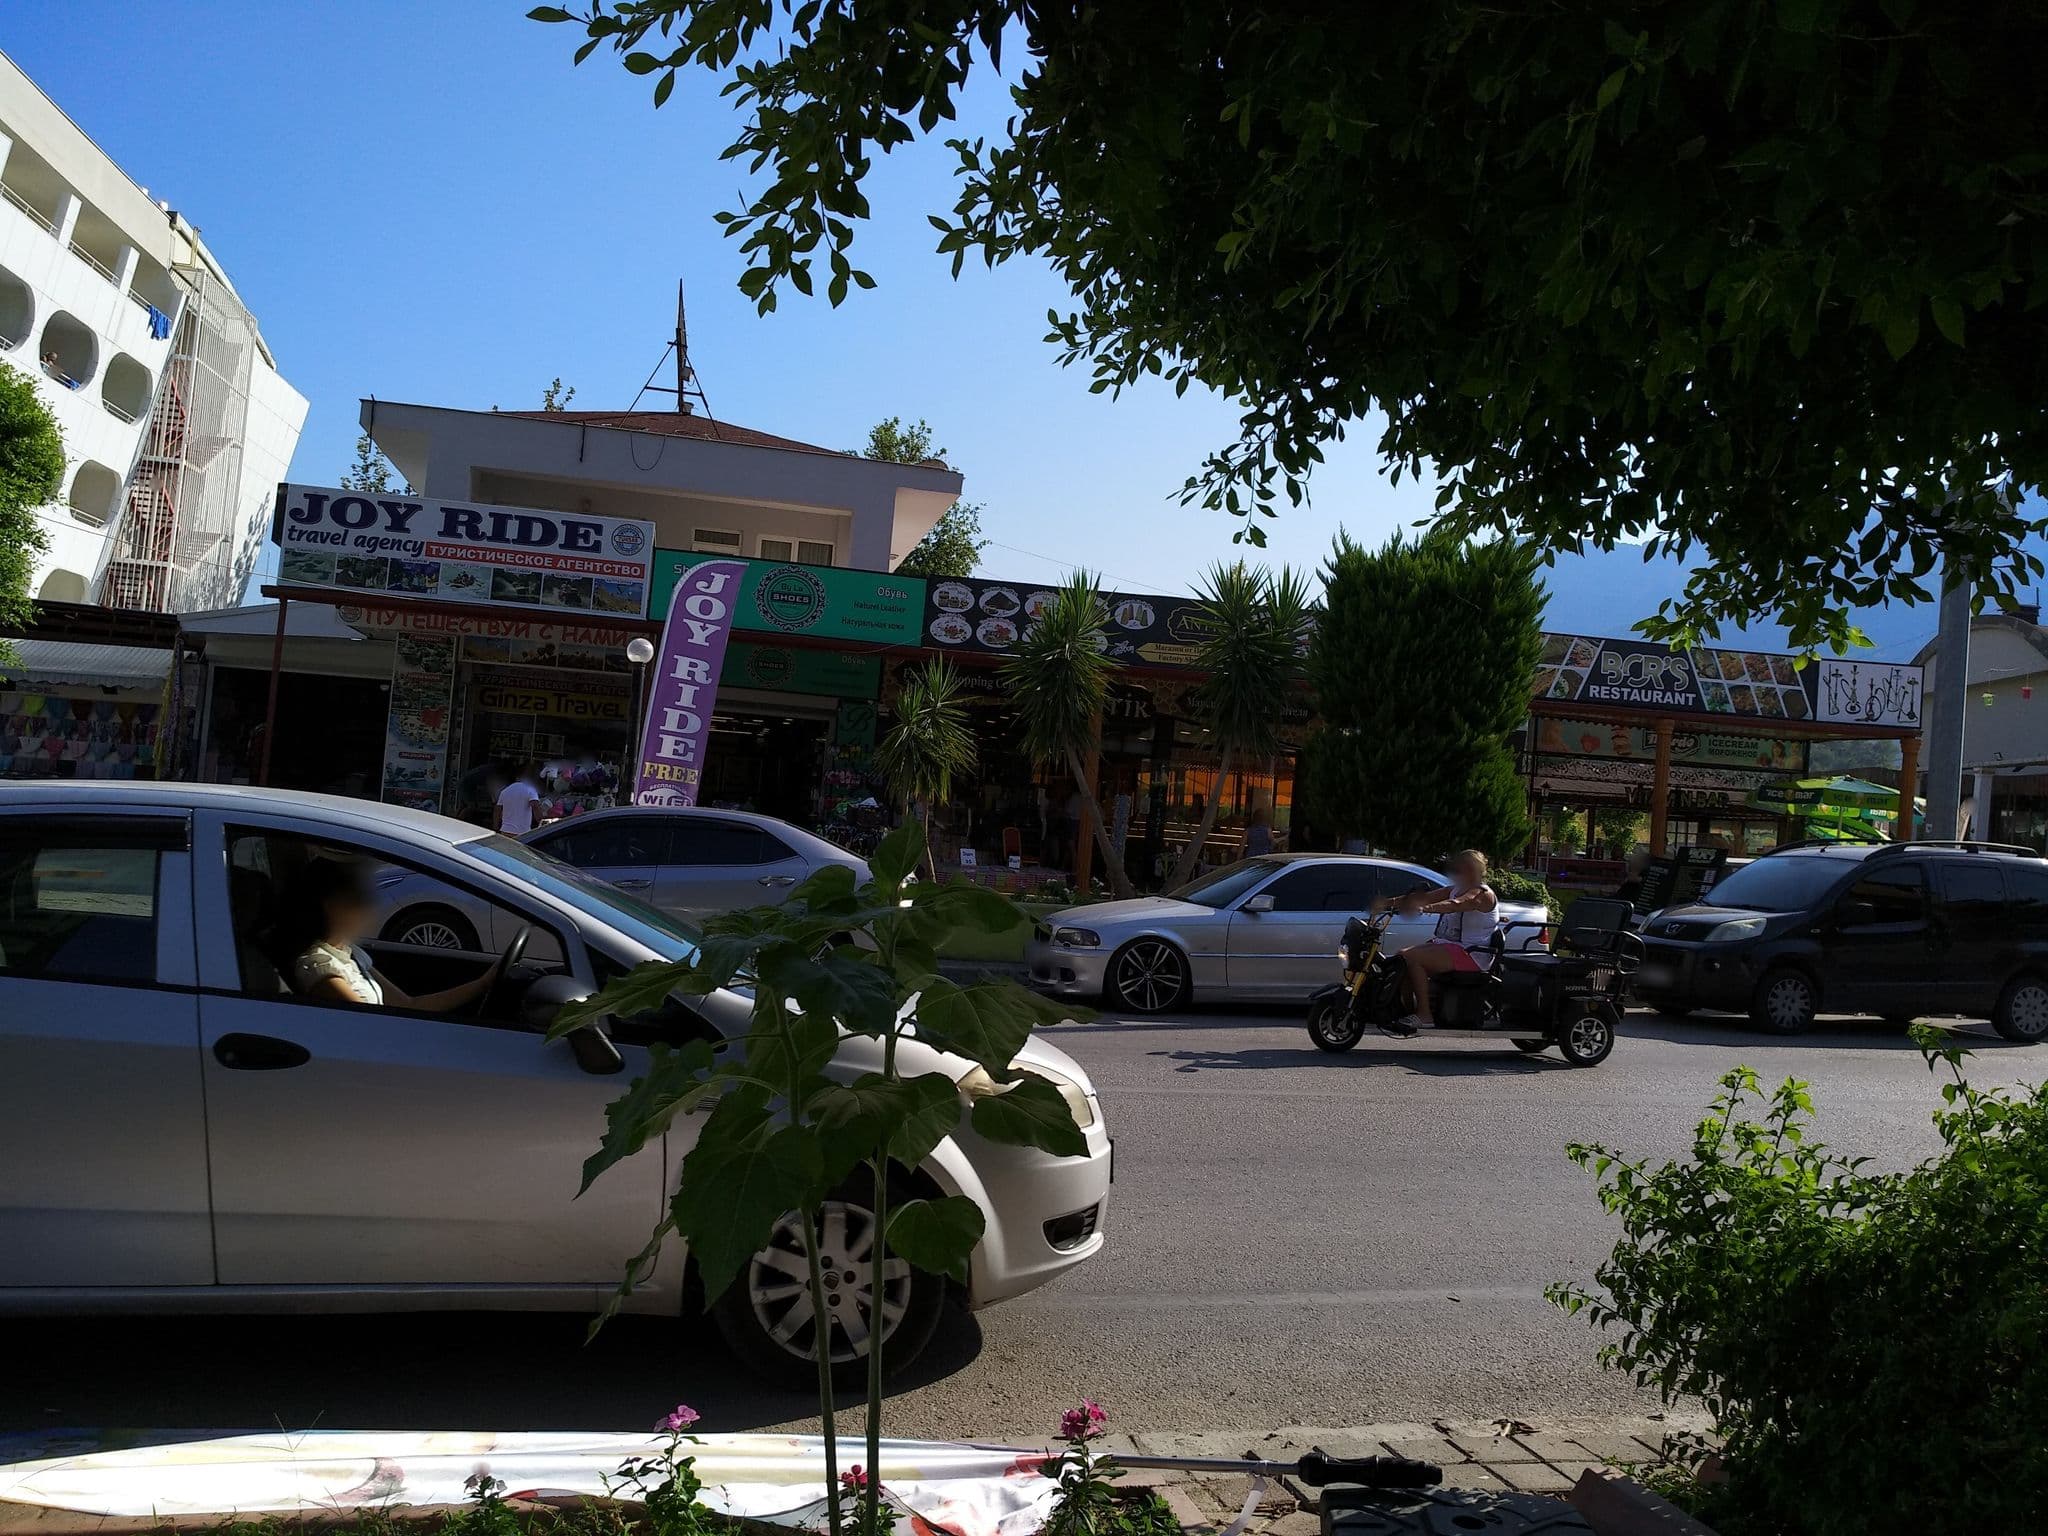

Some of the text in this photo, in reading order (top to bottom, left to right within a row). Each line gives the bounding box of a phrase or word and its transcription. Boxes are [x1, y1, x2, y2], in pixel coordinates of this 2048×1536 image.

[288, 493, 604, 553] JOY RIDE
[287, 524, 425, 557] travel agency
[429, 544, 642, 576] ТУРИСТИЧЕСКОЕ АГЕНТСТВО
[772, 593, 810, 603] SHOES
[877, 586, 908, 600] Обувь
[561, 625, 628, 647] НАМИ
[655, 572, 731, 762] JOY RIDE
[479, 687, 548, 712] Ginza
[1589, 684, 1697, 706] RESTAURANT
[1708, 739, 1759, 749] ICECREAM
[642, 761, 699, 785] FREE
